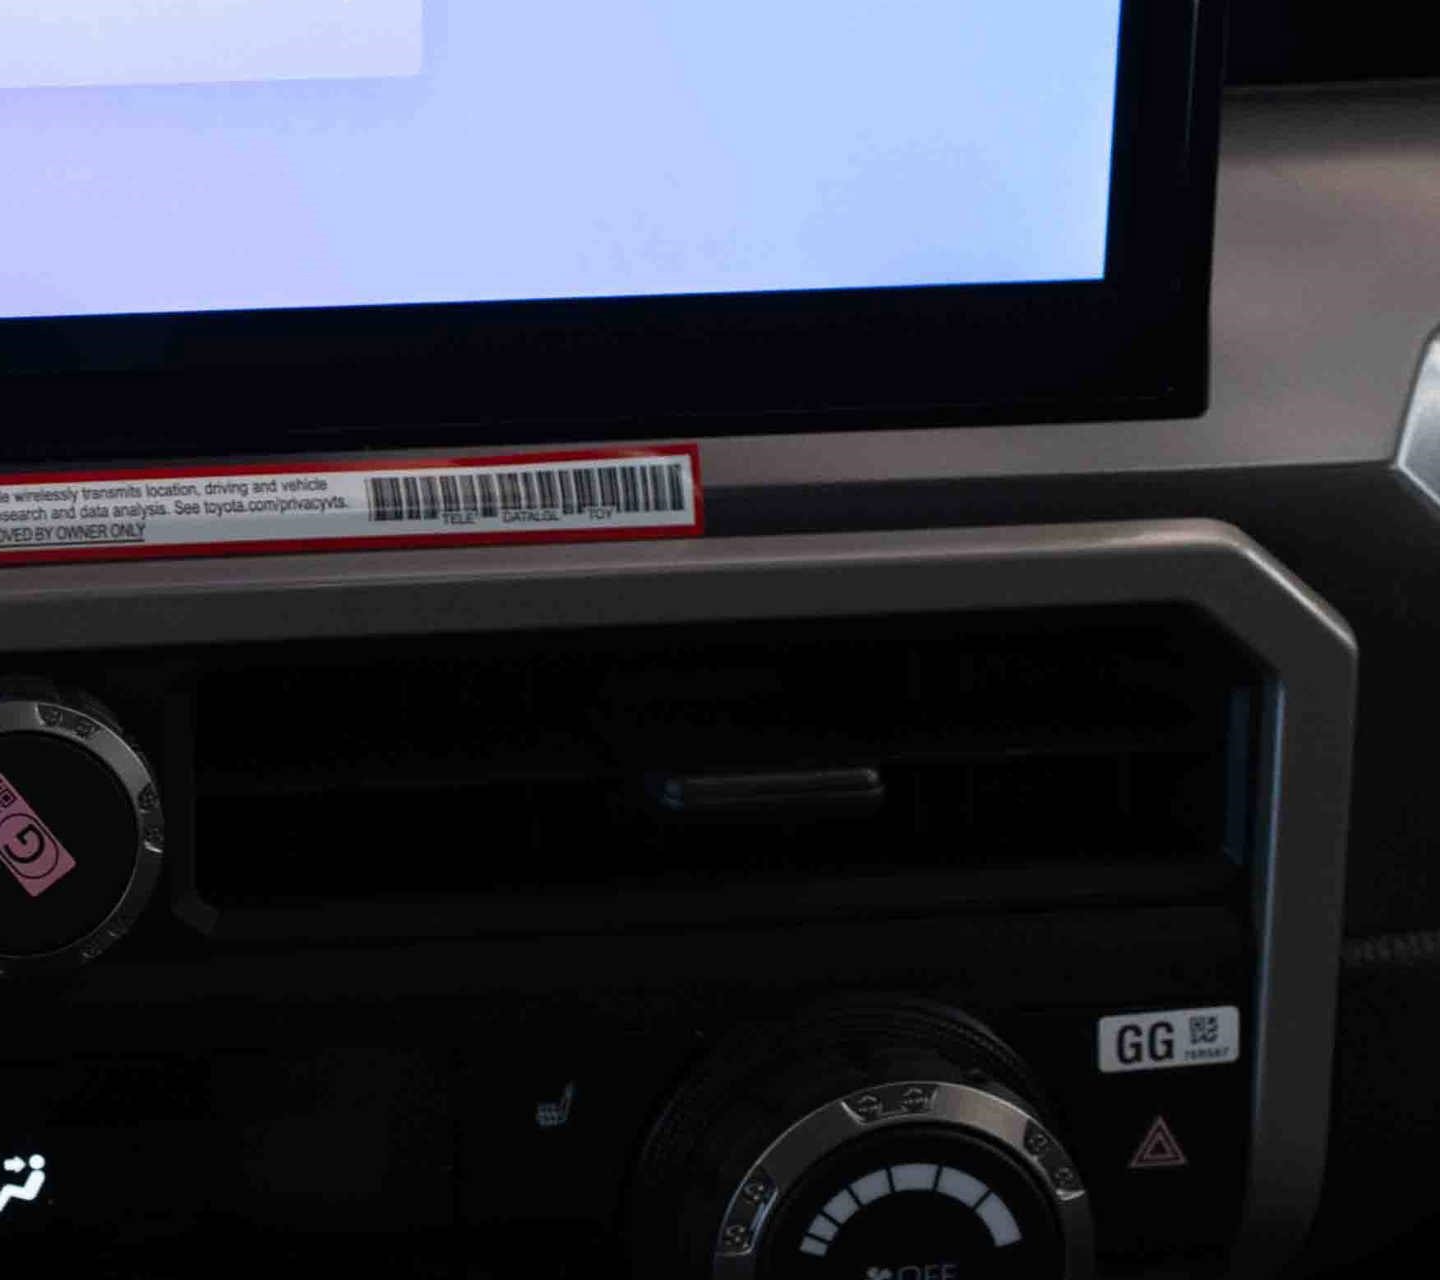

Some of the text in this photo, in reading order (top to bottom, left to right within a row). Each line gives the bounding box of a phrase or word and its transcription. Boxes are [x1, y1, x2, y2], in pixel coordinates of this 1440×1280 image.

[14, 487, 79, 503] wirelessly
[81, 484, 142, 499] transmits
[145, 482, 200, 498] location,
[204, 481, 248, 496] driving
[253, 479, 277, 493] and
[280, 477, 328, 492] vehicle
[51, 505, 76, 520] and
[80, 503, 109, 518] data
[112, 502, 170, 520] analysis.
[174, 499, 201, 515] See
[34, 525, 54, 541] BY
[55, 523, 109, 540] OWNER
[111, 522, 146, 538] ONLY
[3, 823, 45, 863] G
[1116, 1021, 1175, 1066] GG
